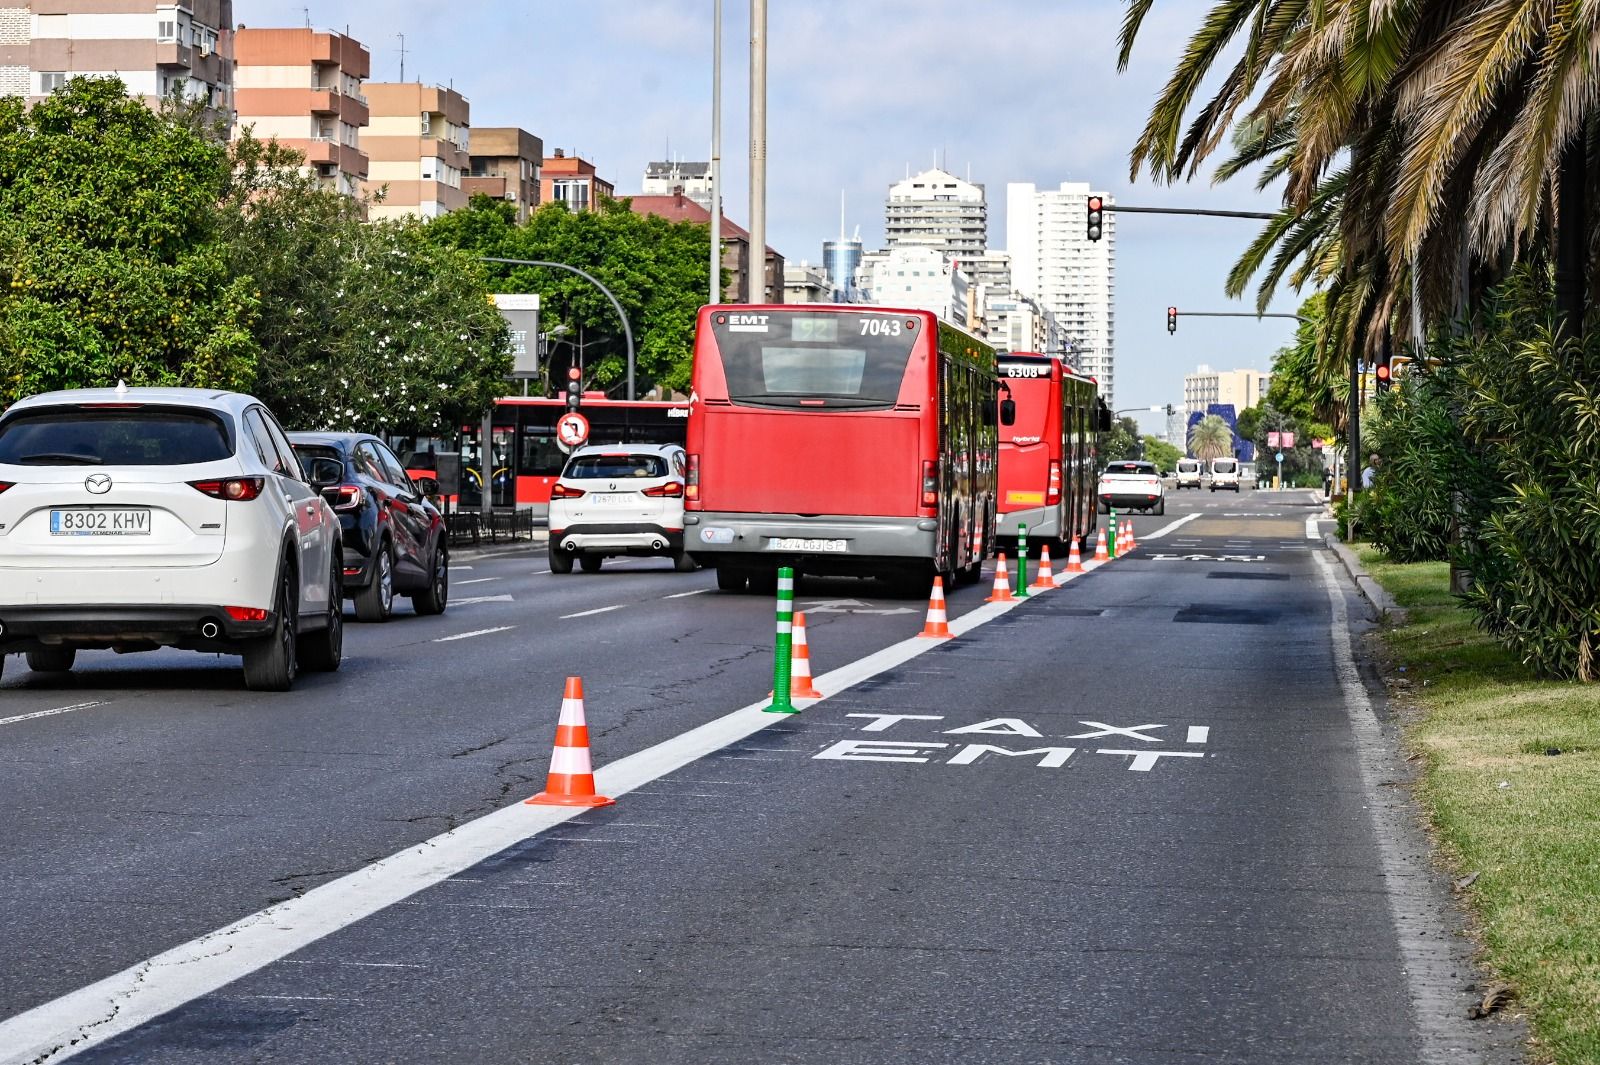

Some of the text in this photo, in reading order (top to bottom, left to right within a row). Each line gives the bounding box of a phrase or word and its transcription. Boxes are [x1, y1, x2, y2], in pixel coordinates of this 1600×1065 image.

[729, 315, 769, 325] EMT
[859, 318, 901, 337] 7043
[800, 321, 828, 339] 92
[1007, 366, 1038, 378] 6308
[64, 512, 146, 529] 8302 KHV
[845, 712, 1210, 743] TAXI
[811, 739, 1205, 772] EMT
